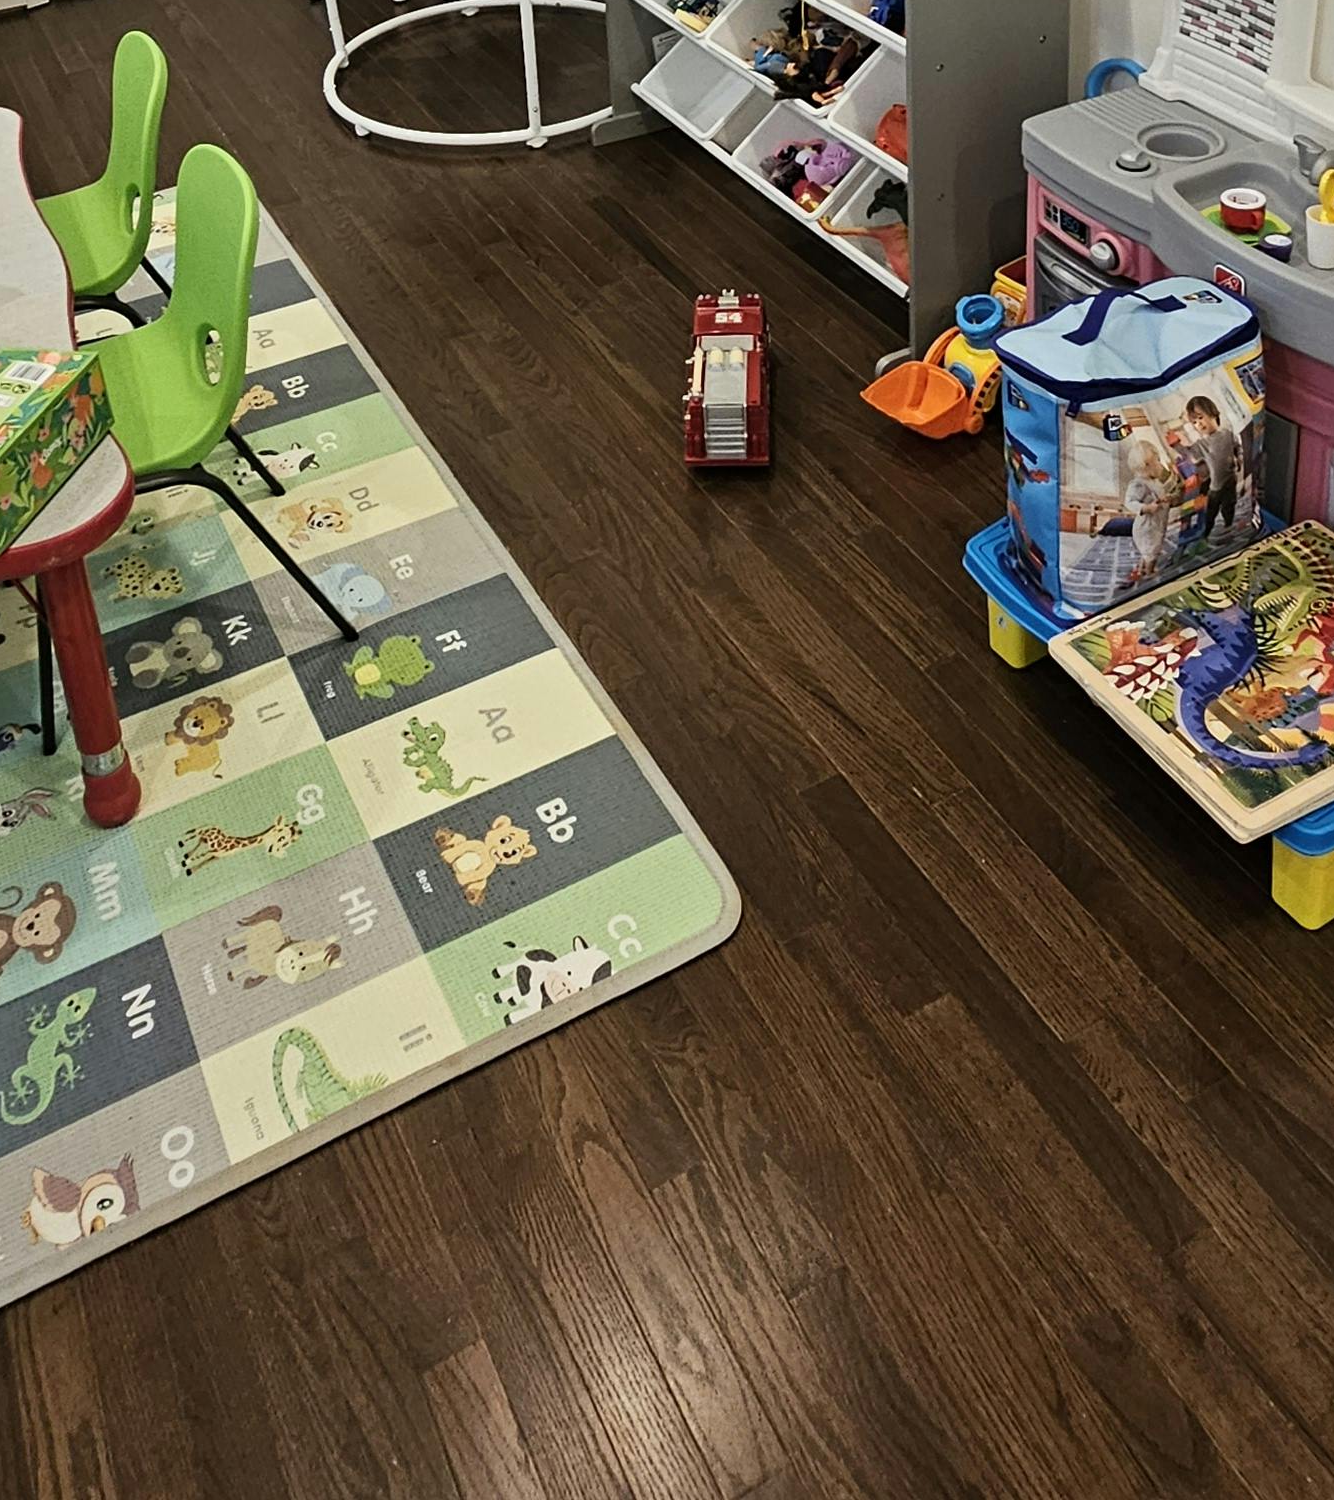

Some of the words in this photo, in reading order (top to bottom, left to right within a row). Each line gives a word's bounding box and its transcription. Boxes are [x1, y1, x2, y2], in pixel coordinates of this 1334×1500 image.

[252, 328, 276, 349] Aa
[281, 375, 310, 399] Bb
[317, 431, 338, 452] Cc
[348, 486, 379, 512] Dd
[388, 554, 414, 580] Ee
[221, 614, 252, 646] Kk
[435, 629, 467, 653] Ff
[478, 706, 516, 744] Aa
[361, 757, 385, 795] Alligator
[296, 783, 326, 826] Gg
[535, 797, 578, 844] Bb
[88, 861, 123, 922] Mm
[415, 868, 435, 895] Bear
[338, 886, 378, 936] Hh
[607, 914, 643, 959] Cc
[121, 983, 157, 1040] Nn
[243, 1096, 266, 1142] Iguana
[160, 1124, 196, 1189] Oo
